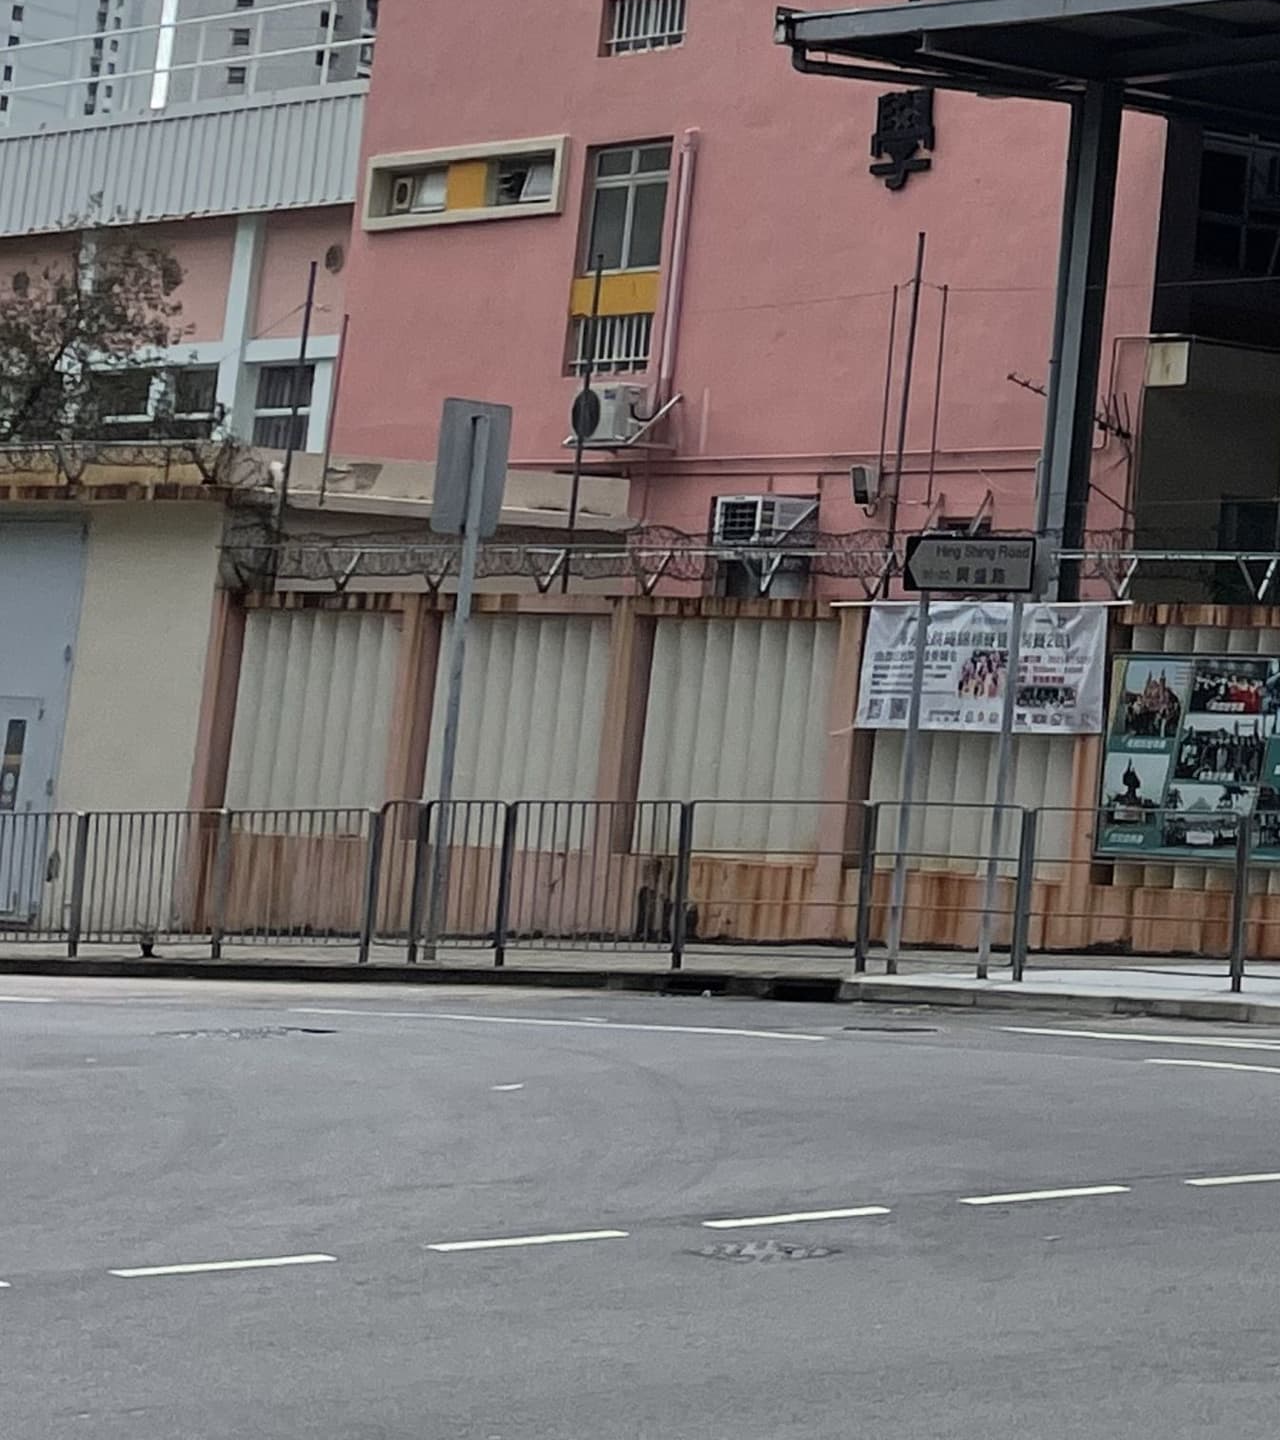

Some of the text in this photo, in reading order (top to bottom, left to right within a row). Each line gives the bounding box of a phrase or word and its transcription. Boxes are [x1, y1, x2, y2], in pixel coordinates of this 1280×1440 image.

[936, 545, 1030, 561] Hing Shing Road
